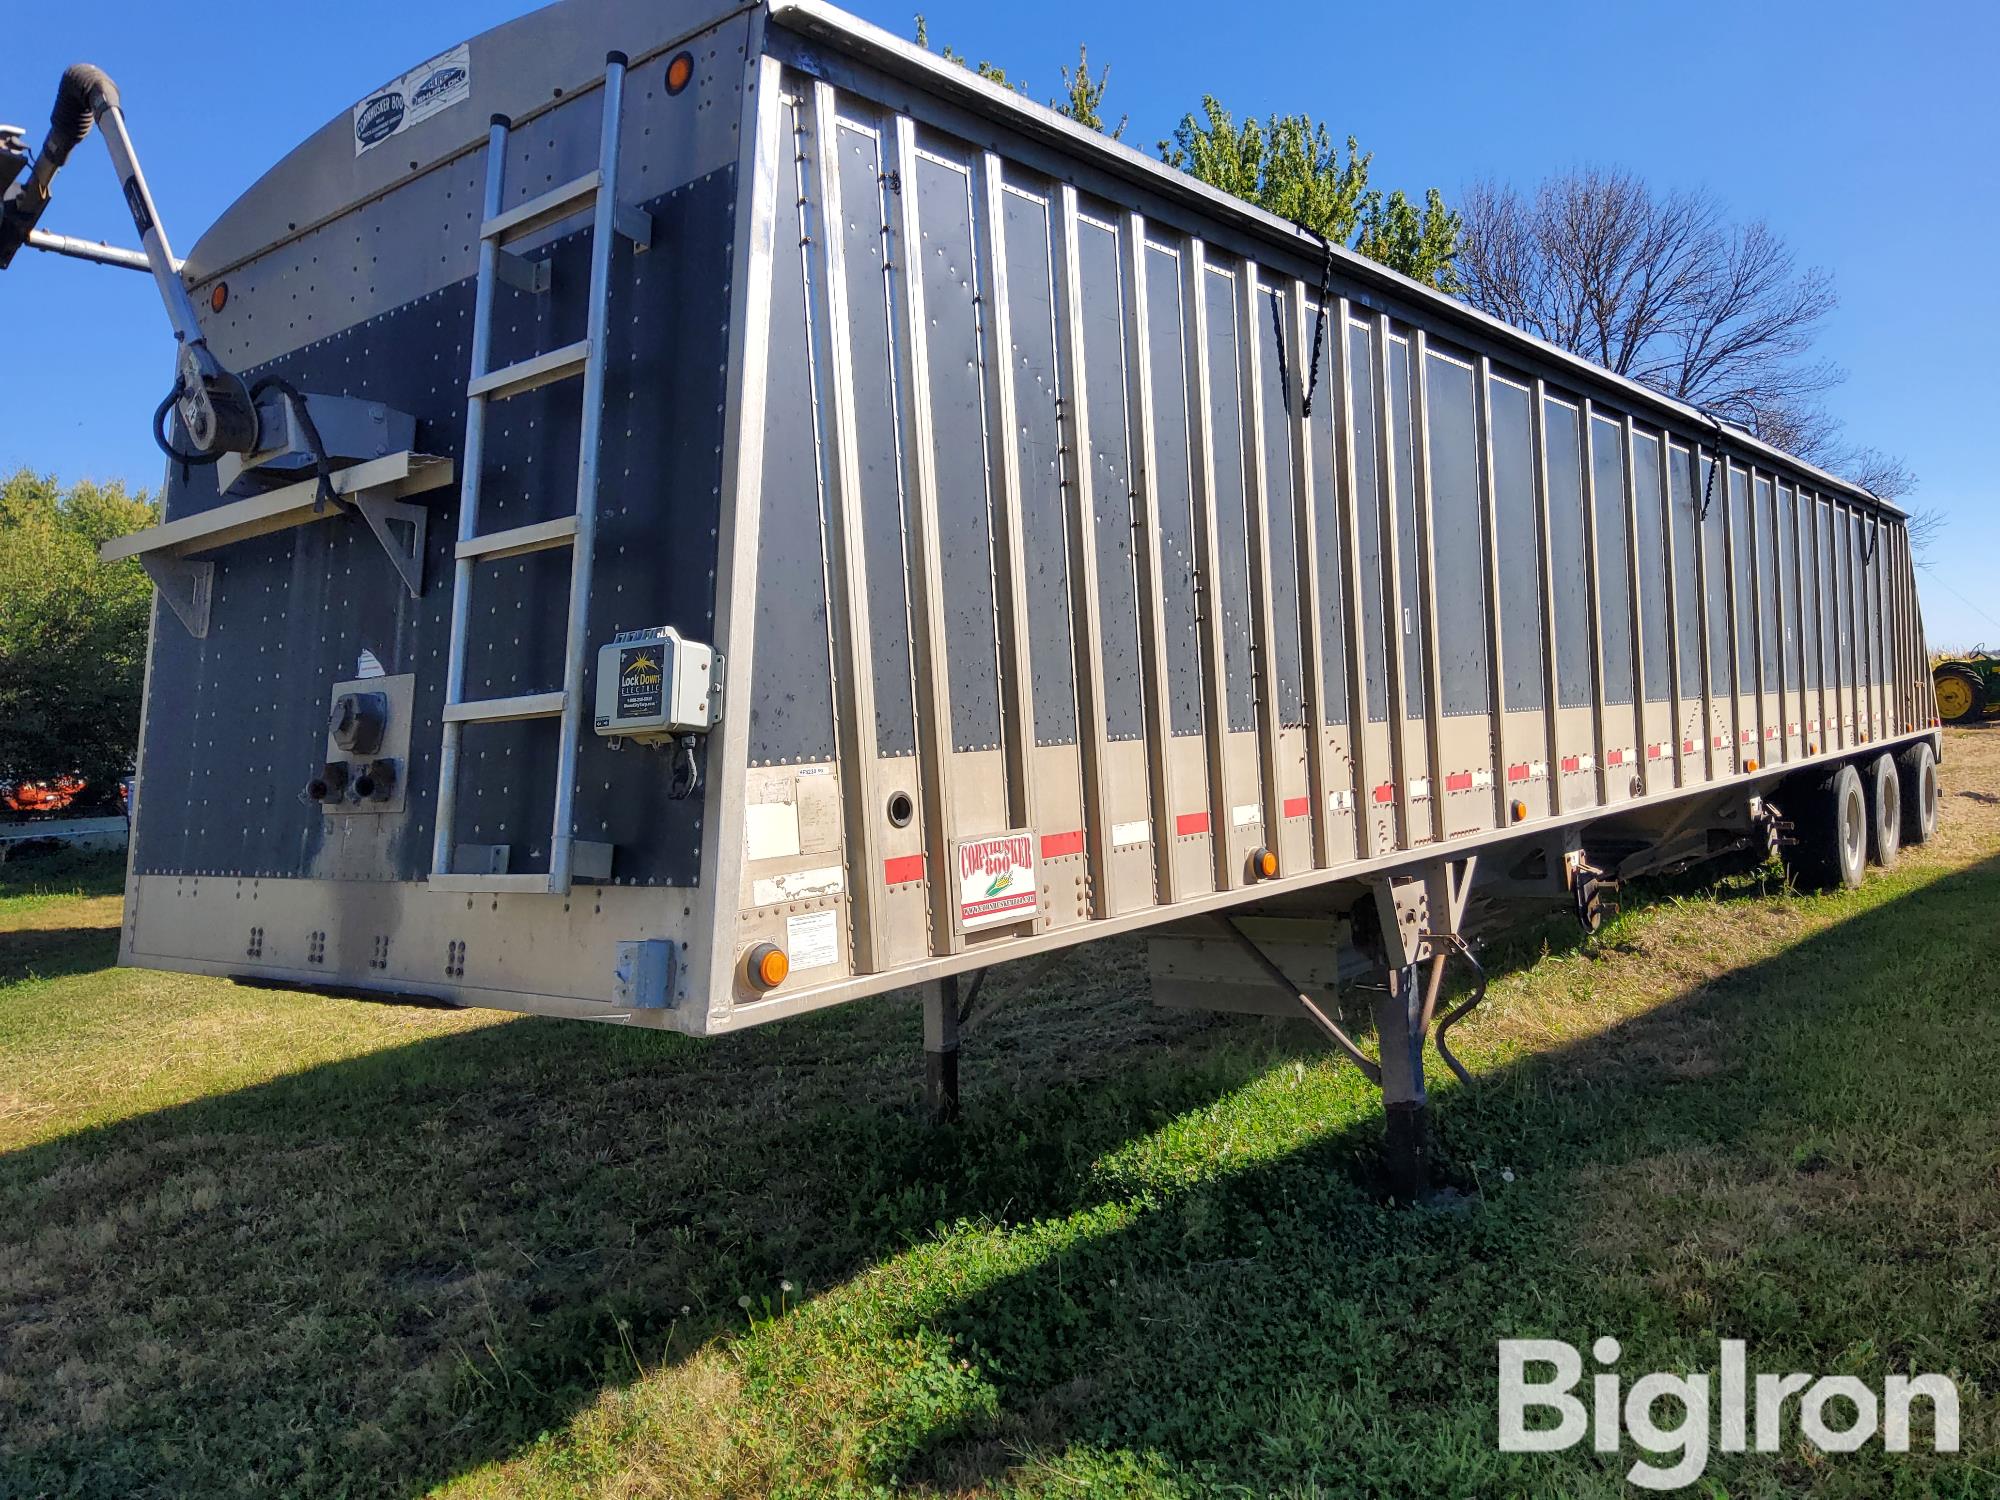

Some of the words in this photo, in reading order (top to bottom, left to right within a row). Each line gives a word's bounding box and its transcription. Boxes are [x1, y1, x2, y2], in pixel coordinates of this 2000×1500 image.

[417, 76, 460, 104] SHUR-LOK
[356, 97, 390, 137] CORNHUSKER
[391, 95, 404, 110] 800
[621, 684, 660, 695] ELECTRIC
[961, 836, 1032, 880] CORNHUSKER
[984, 856, 1011, 876] 800
